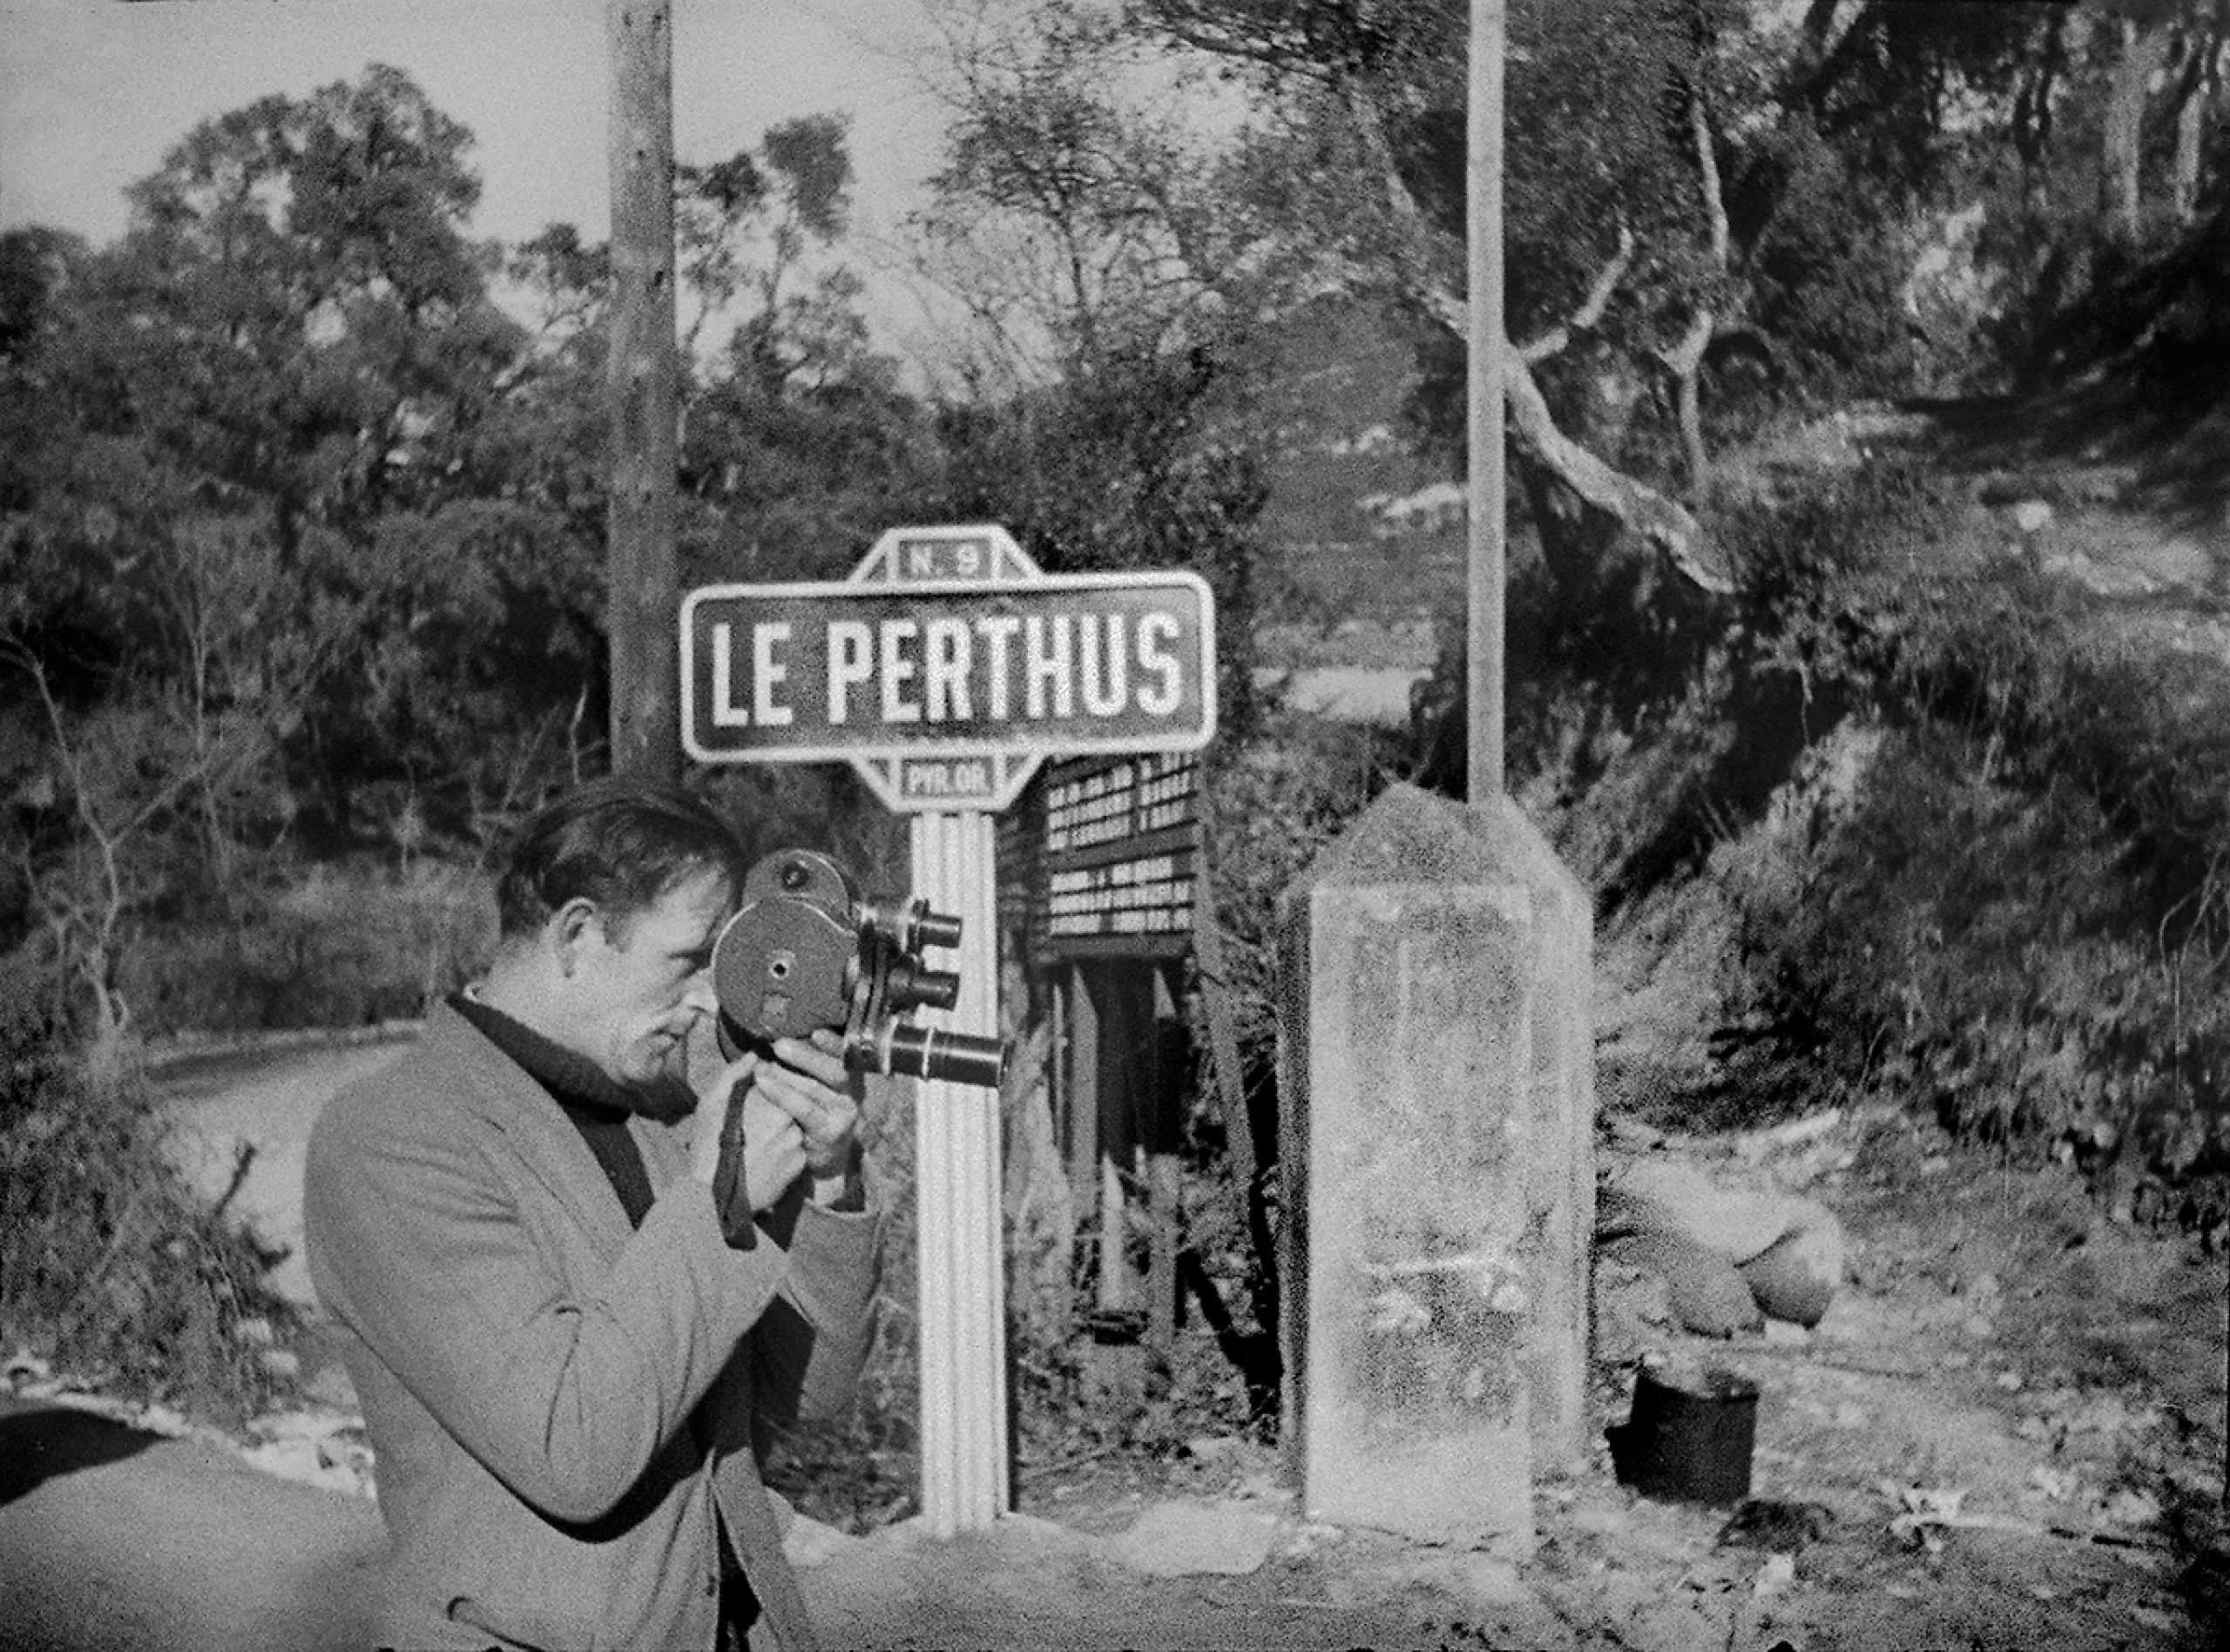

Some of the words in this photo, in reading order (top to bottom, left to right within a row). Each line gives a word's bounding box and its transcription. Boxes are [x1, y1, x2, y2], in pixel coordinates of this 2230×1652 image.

[957, 544, 979, 575] 9
[712, 622, 794, 726] LE
[828, 612, 1181, 725] PERTHUS
